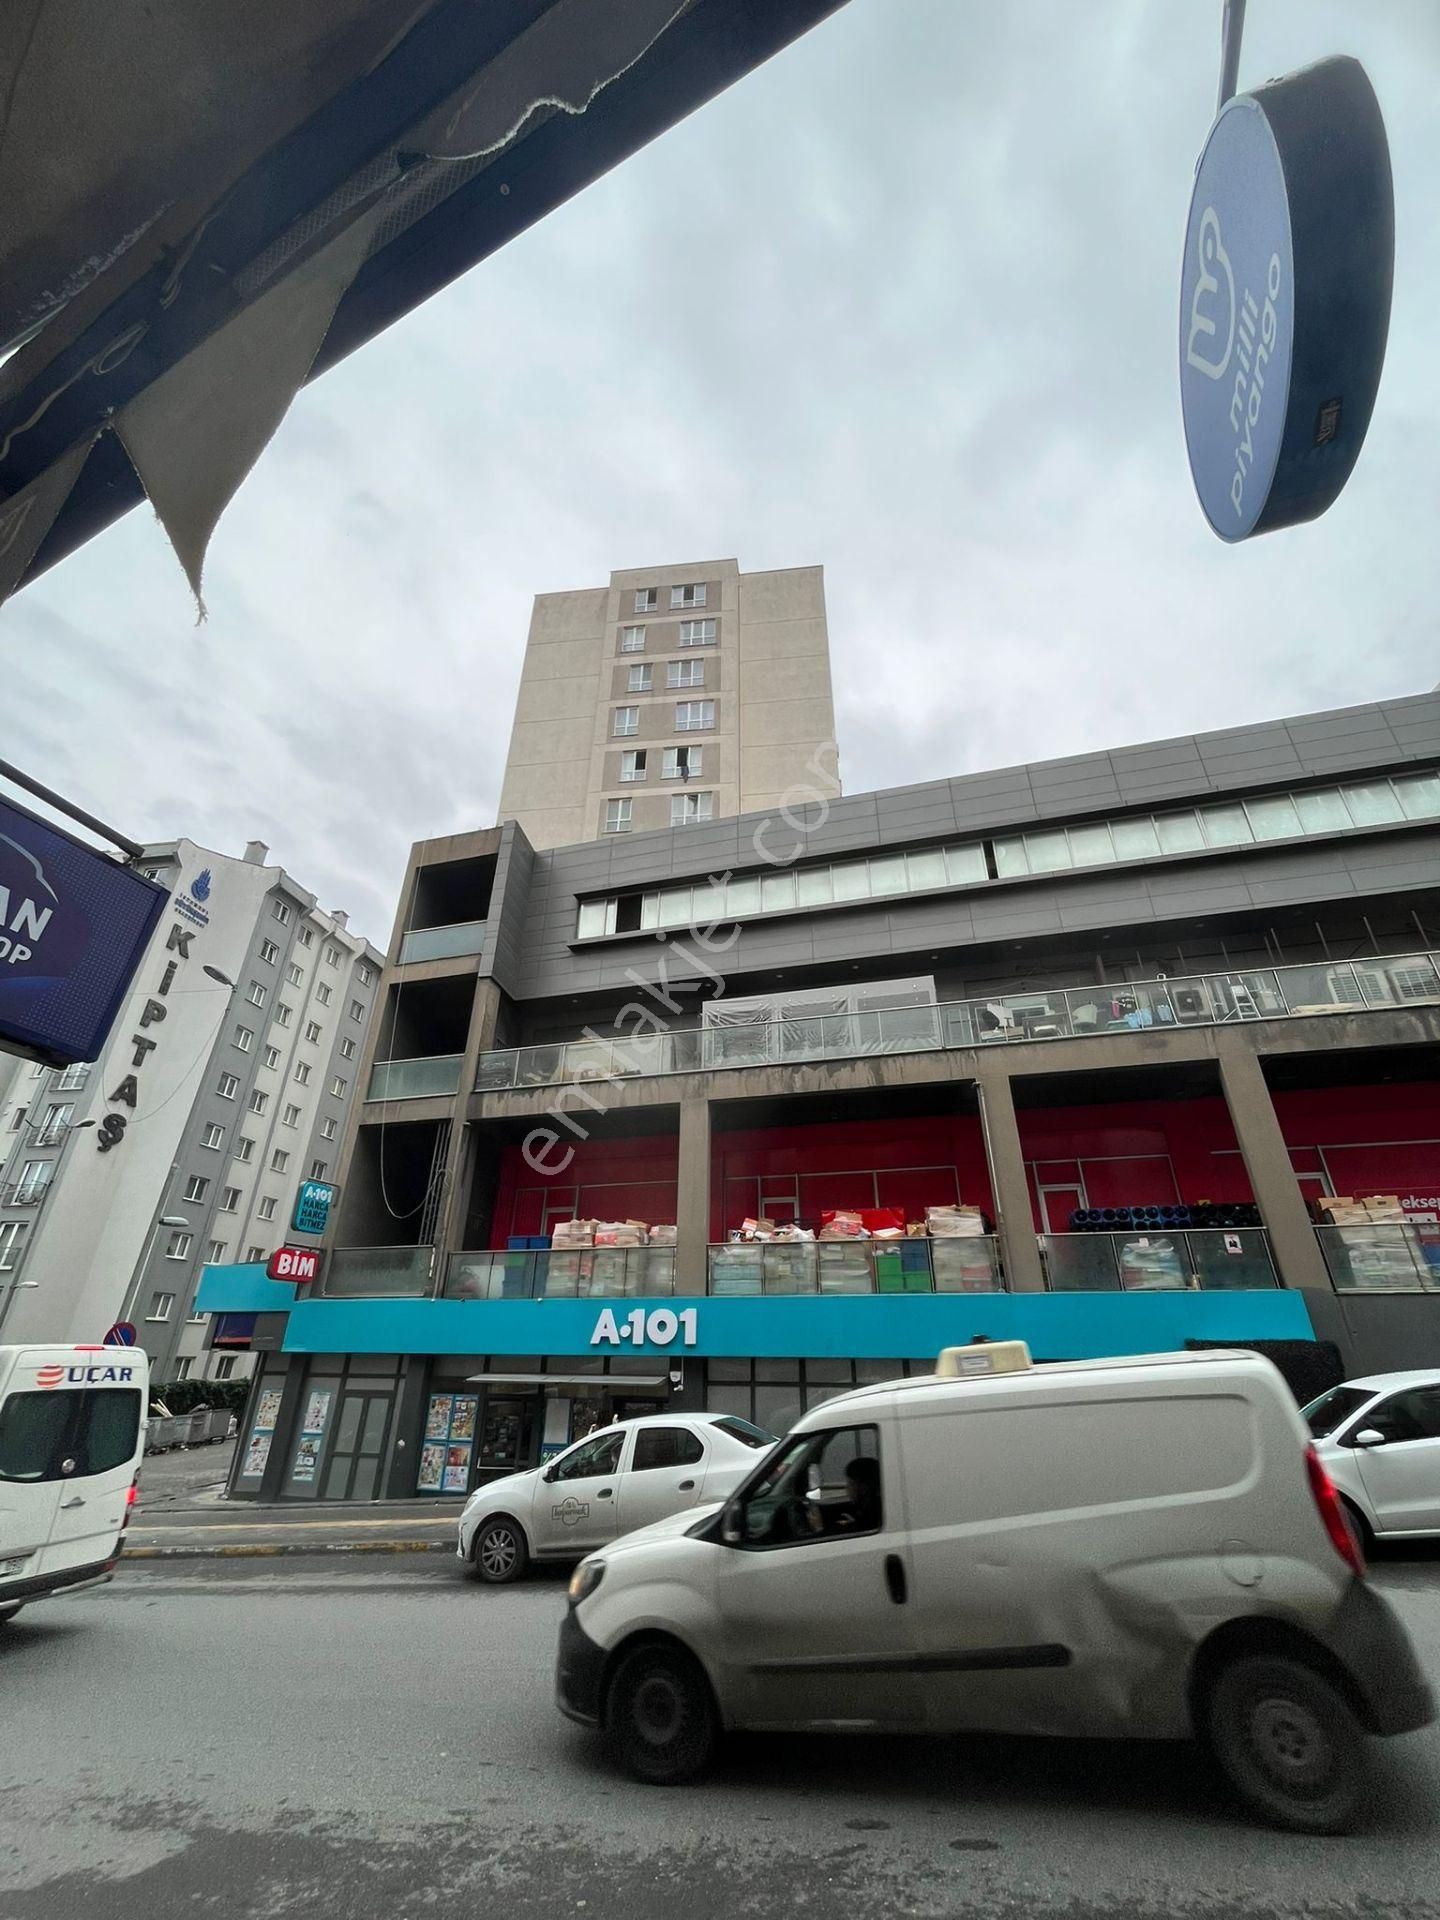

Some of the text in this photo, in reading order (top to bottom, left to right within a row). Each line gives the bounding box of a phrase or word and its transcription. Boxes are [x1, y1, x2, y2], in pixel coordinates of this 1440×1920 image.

[1230, 288, 1259, 433] milli
[1231, 252, 1281, 518] piyango
[97, 922, 197, 1153] KİPTAŞ
[277, 1250, 316, 1278] BİM
[67, 1367, 133, 1384] UÇAR
